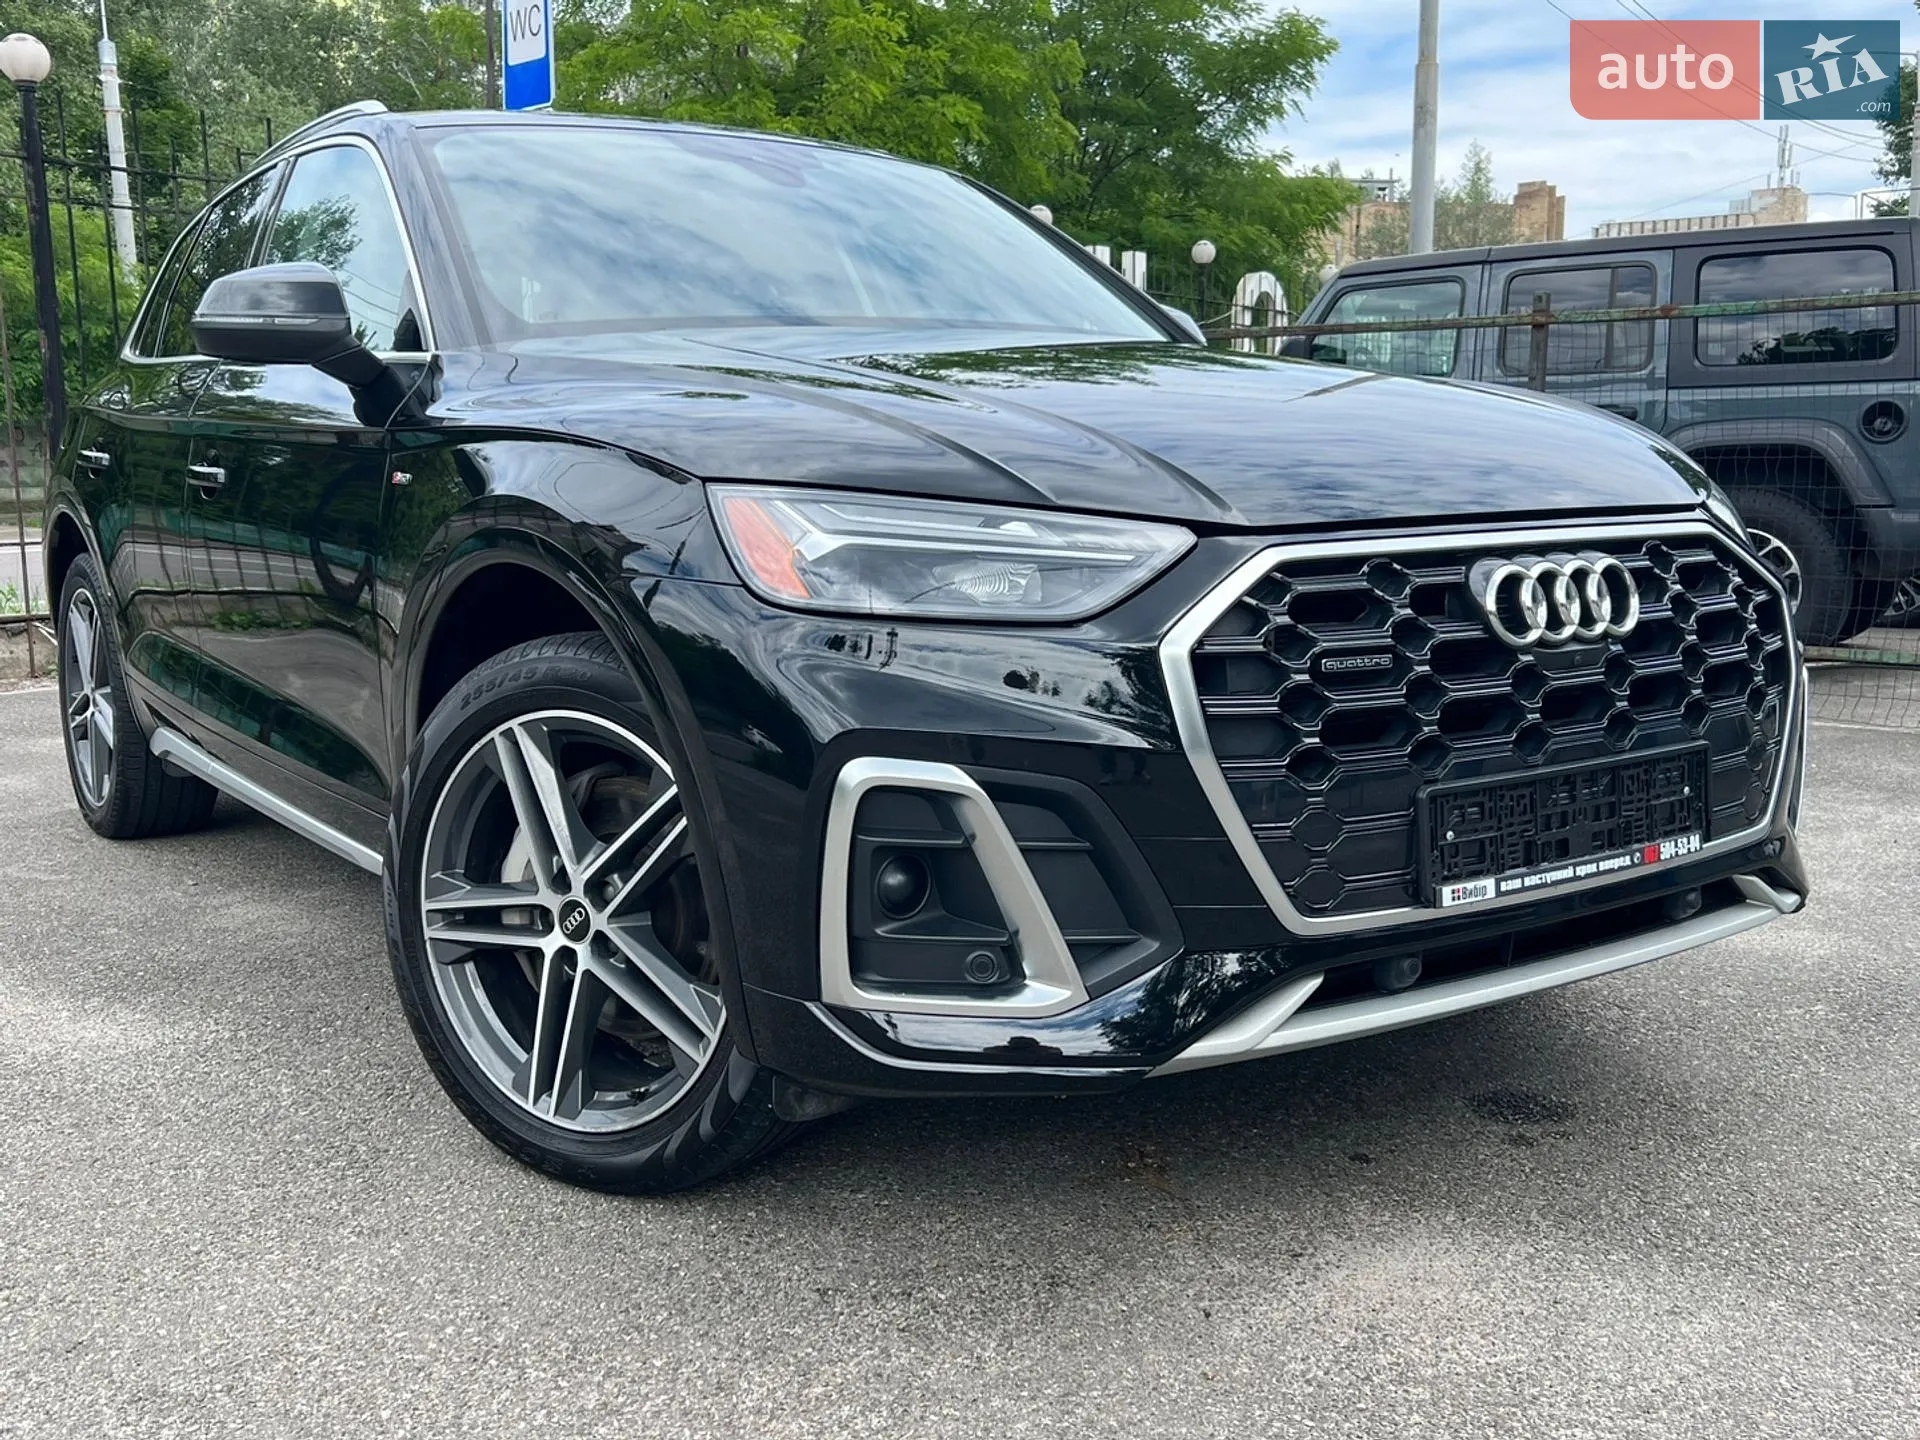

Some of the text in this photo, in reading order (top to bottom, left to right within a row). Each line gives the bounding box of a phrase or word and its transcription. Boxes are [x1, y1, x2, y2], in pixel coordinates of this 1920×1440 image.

[509, 4, 542, 42] WC
[1325, 657, 1391, 672] quattro
[1461, 884, 1488, 900] Вибір
